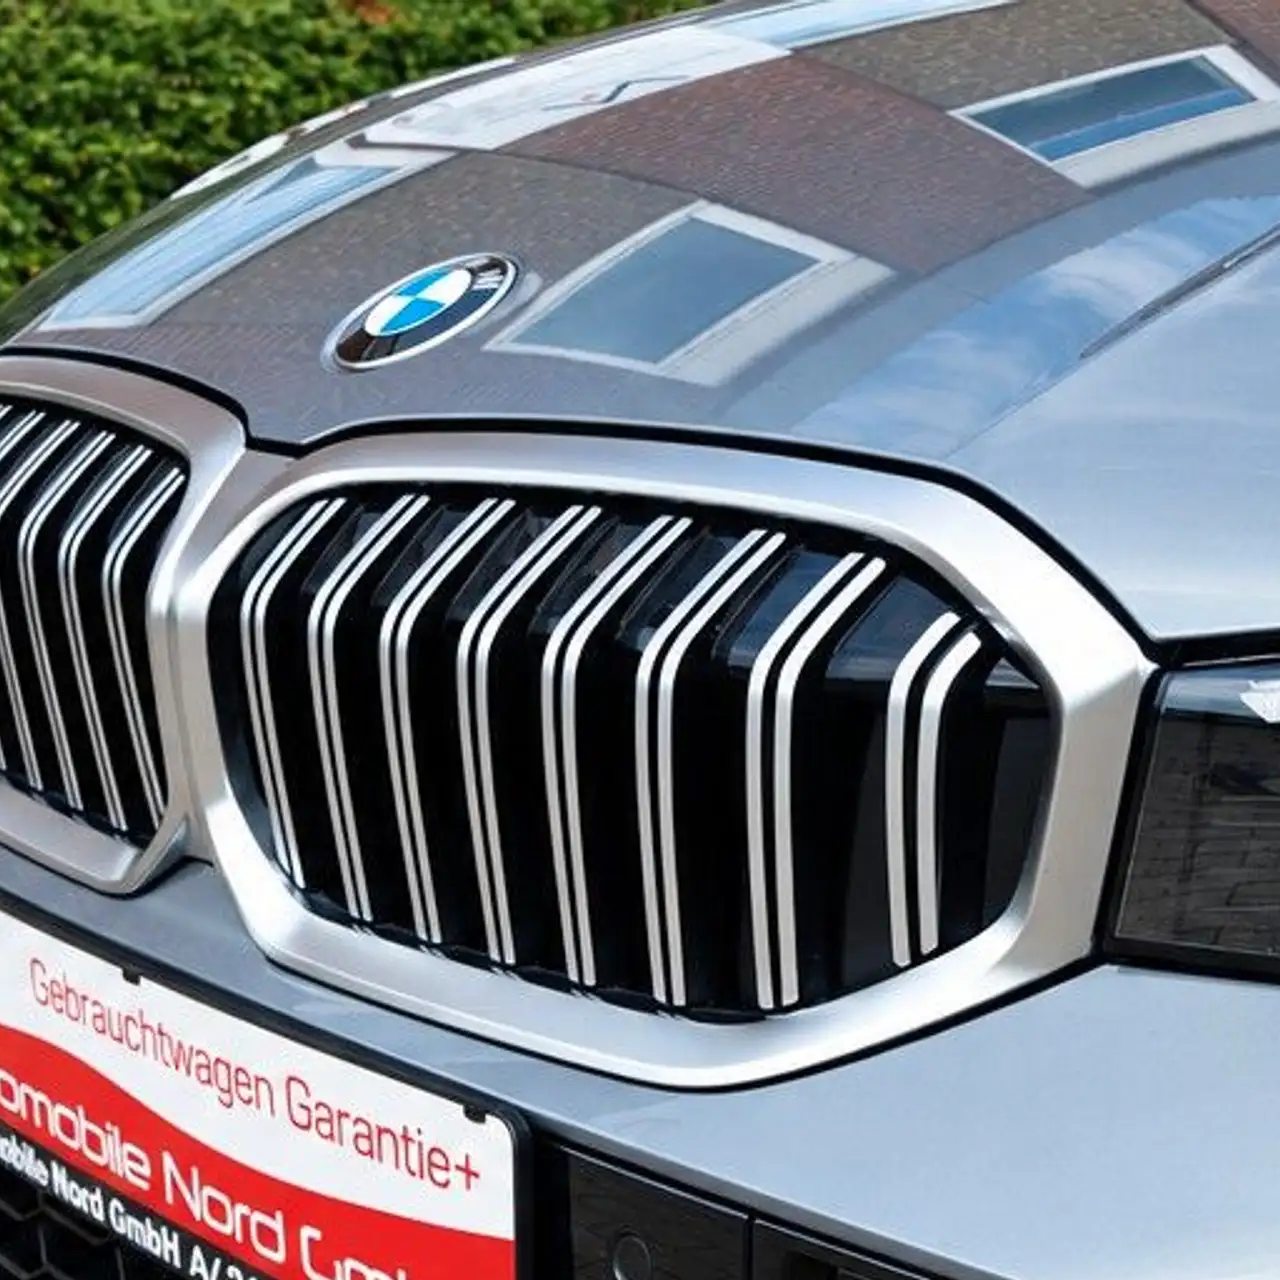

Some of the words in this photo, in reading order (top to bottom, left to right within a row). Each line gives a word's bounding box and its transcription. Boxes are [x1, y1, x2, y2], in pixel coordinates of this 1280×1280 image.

[29, 957, 276, 1118] Gebrauchtwagen
[285, 1075, 481, 1191] Garantie+
[50, 1160, 105, 1222] Nord
[108, 1197, 182, 1269] GmbH
[162, 1151, 286, 1265] Nord
